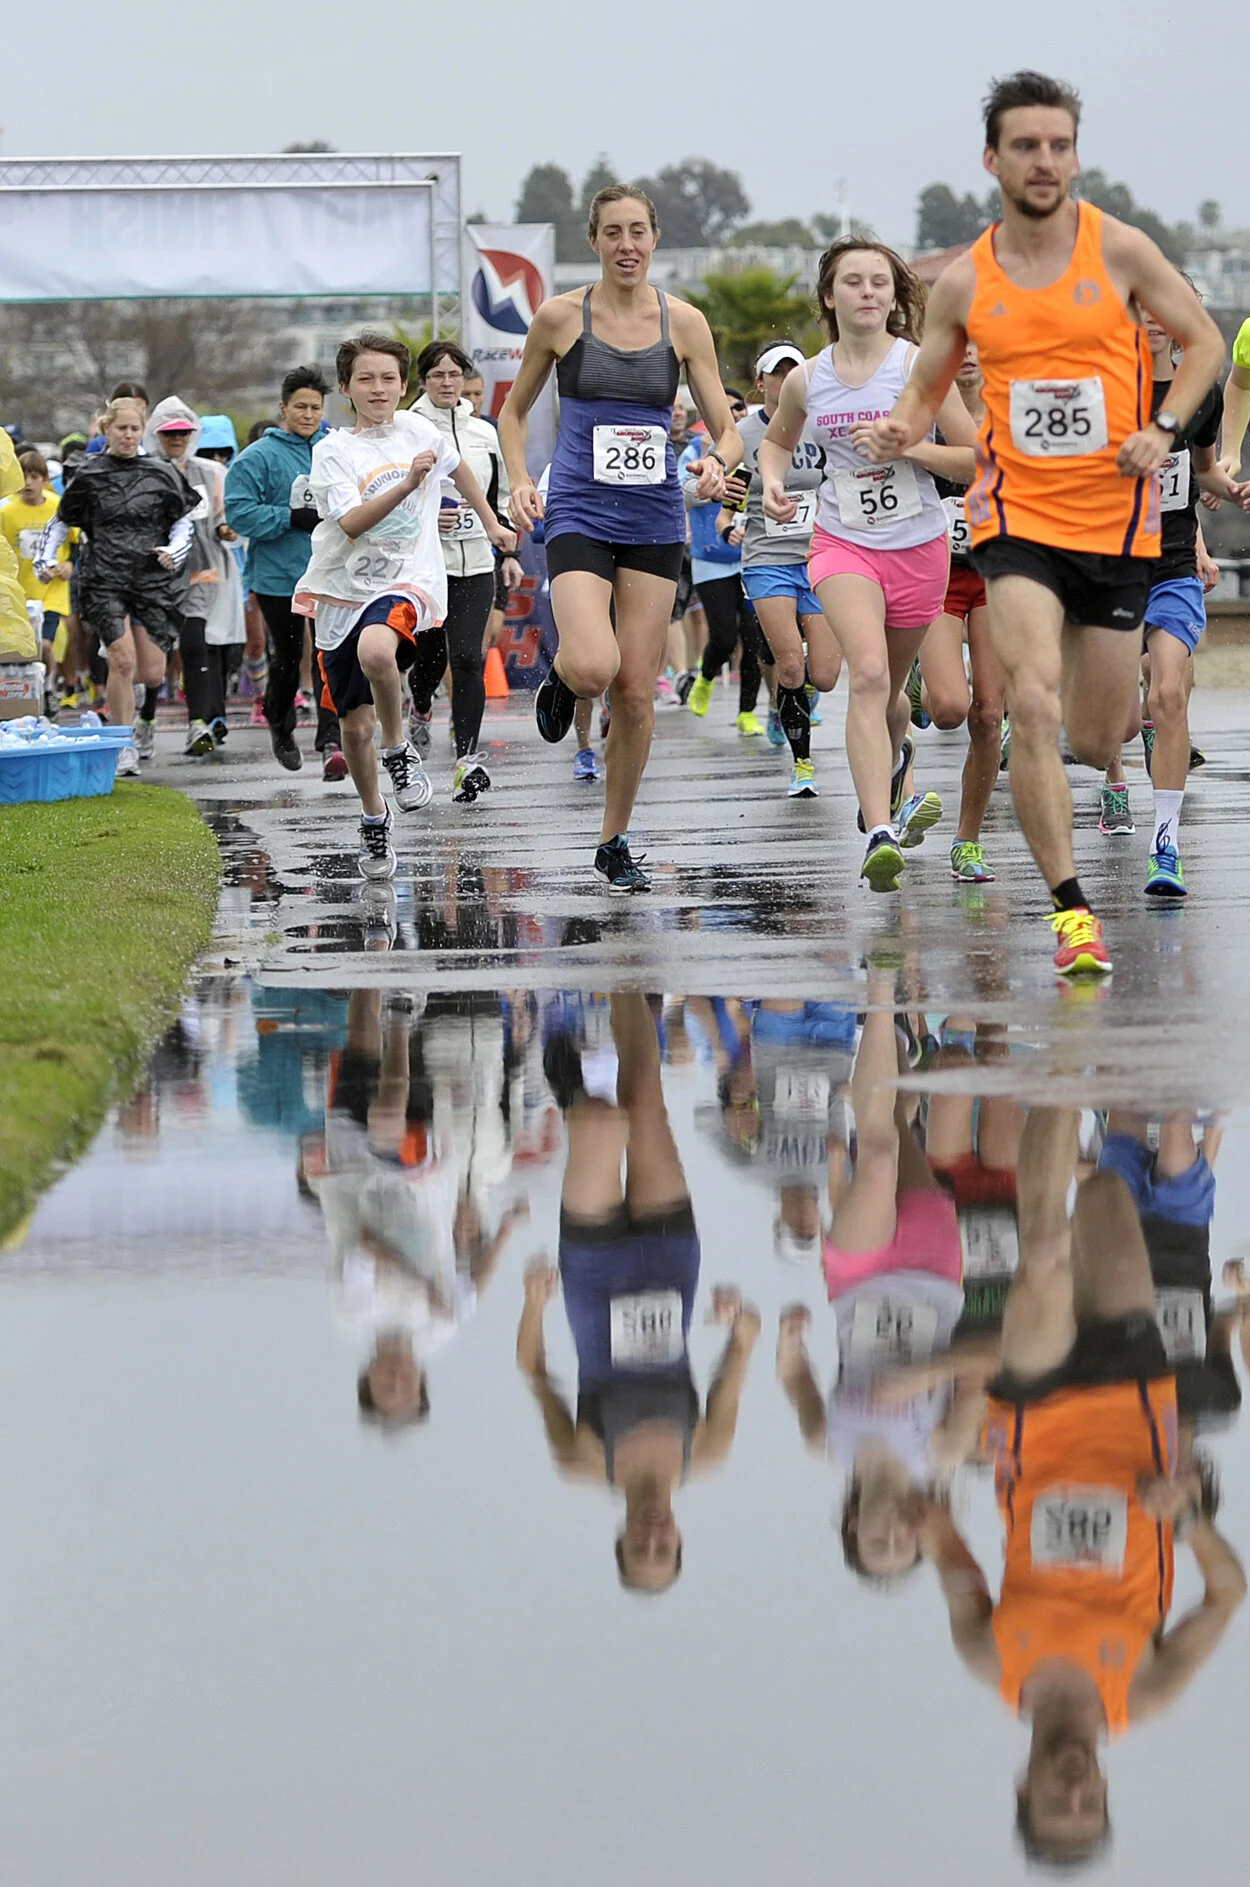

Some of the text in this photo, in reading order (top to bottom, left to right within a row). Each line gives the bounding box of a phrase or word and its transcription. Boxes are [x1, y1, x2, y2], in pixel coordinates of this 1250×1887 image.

[816, 409, 891, 427] SOUTH COAS
[1025, 408, 1091, 437] 285
[606, 447, 656, 470] 286
[859, 485, 898, 515] 56
[354, 556, 405, 579] 227
